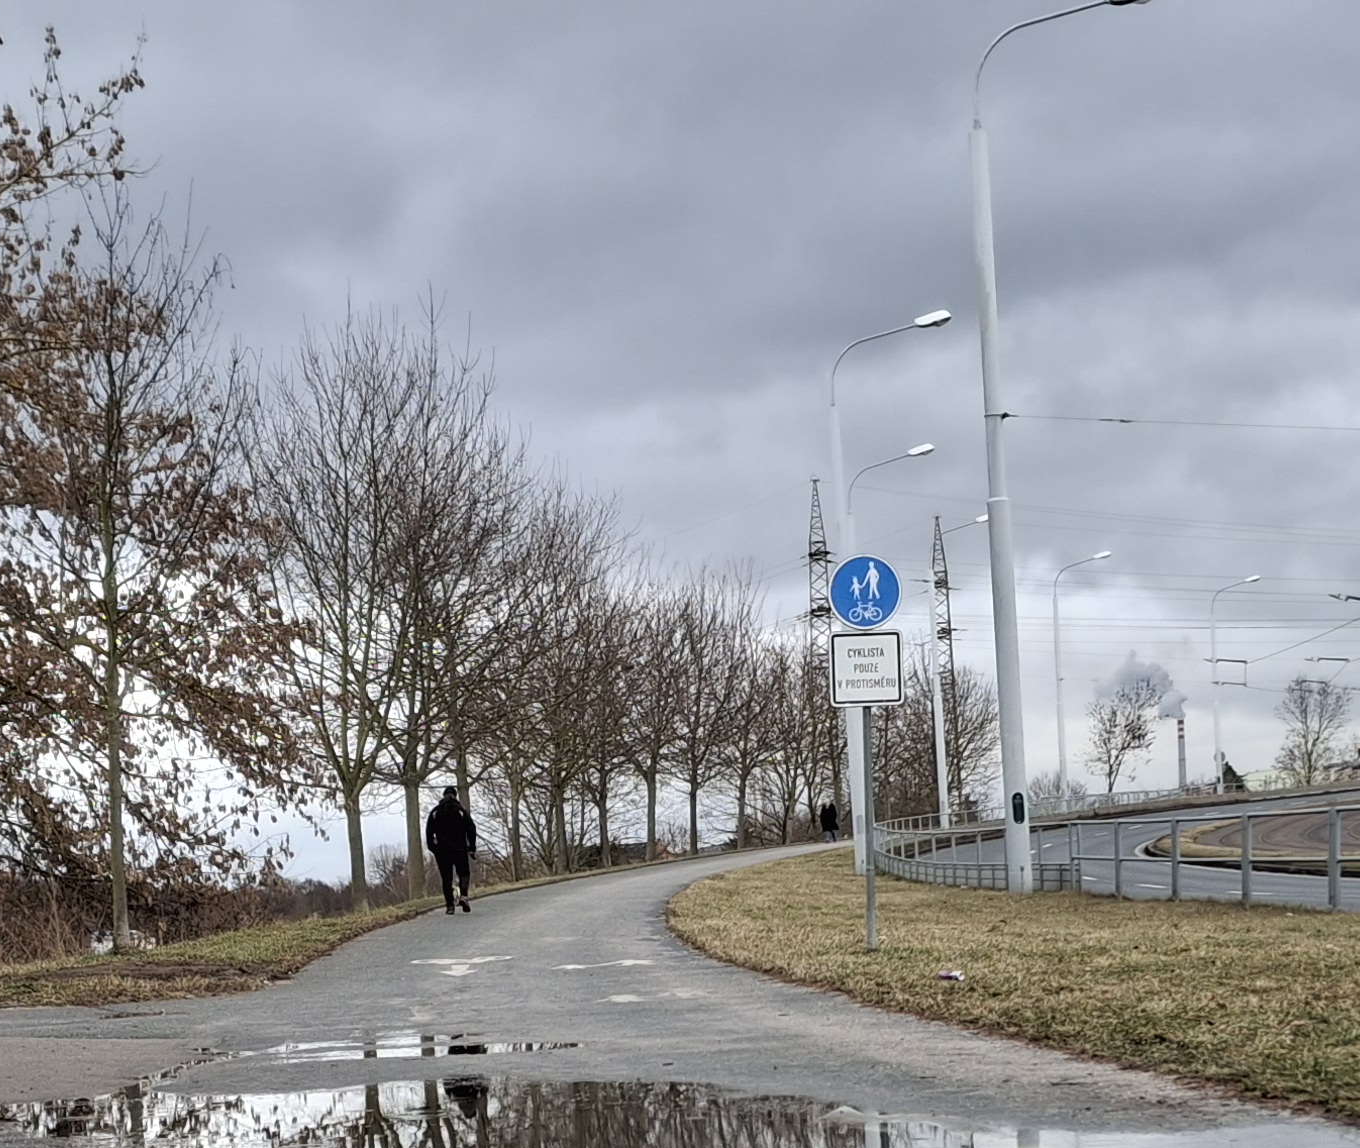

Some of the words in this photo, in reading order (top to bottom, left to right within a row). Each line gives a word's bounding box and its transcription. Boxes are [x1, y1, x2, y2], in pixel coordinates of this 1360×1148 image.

[847, 648, 884, 658] CYKLISTA
[854, 663, 879, 673] POUZE
[837, 680, 843, 689] V
